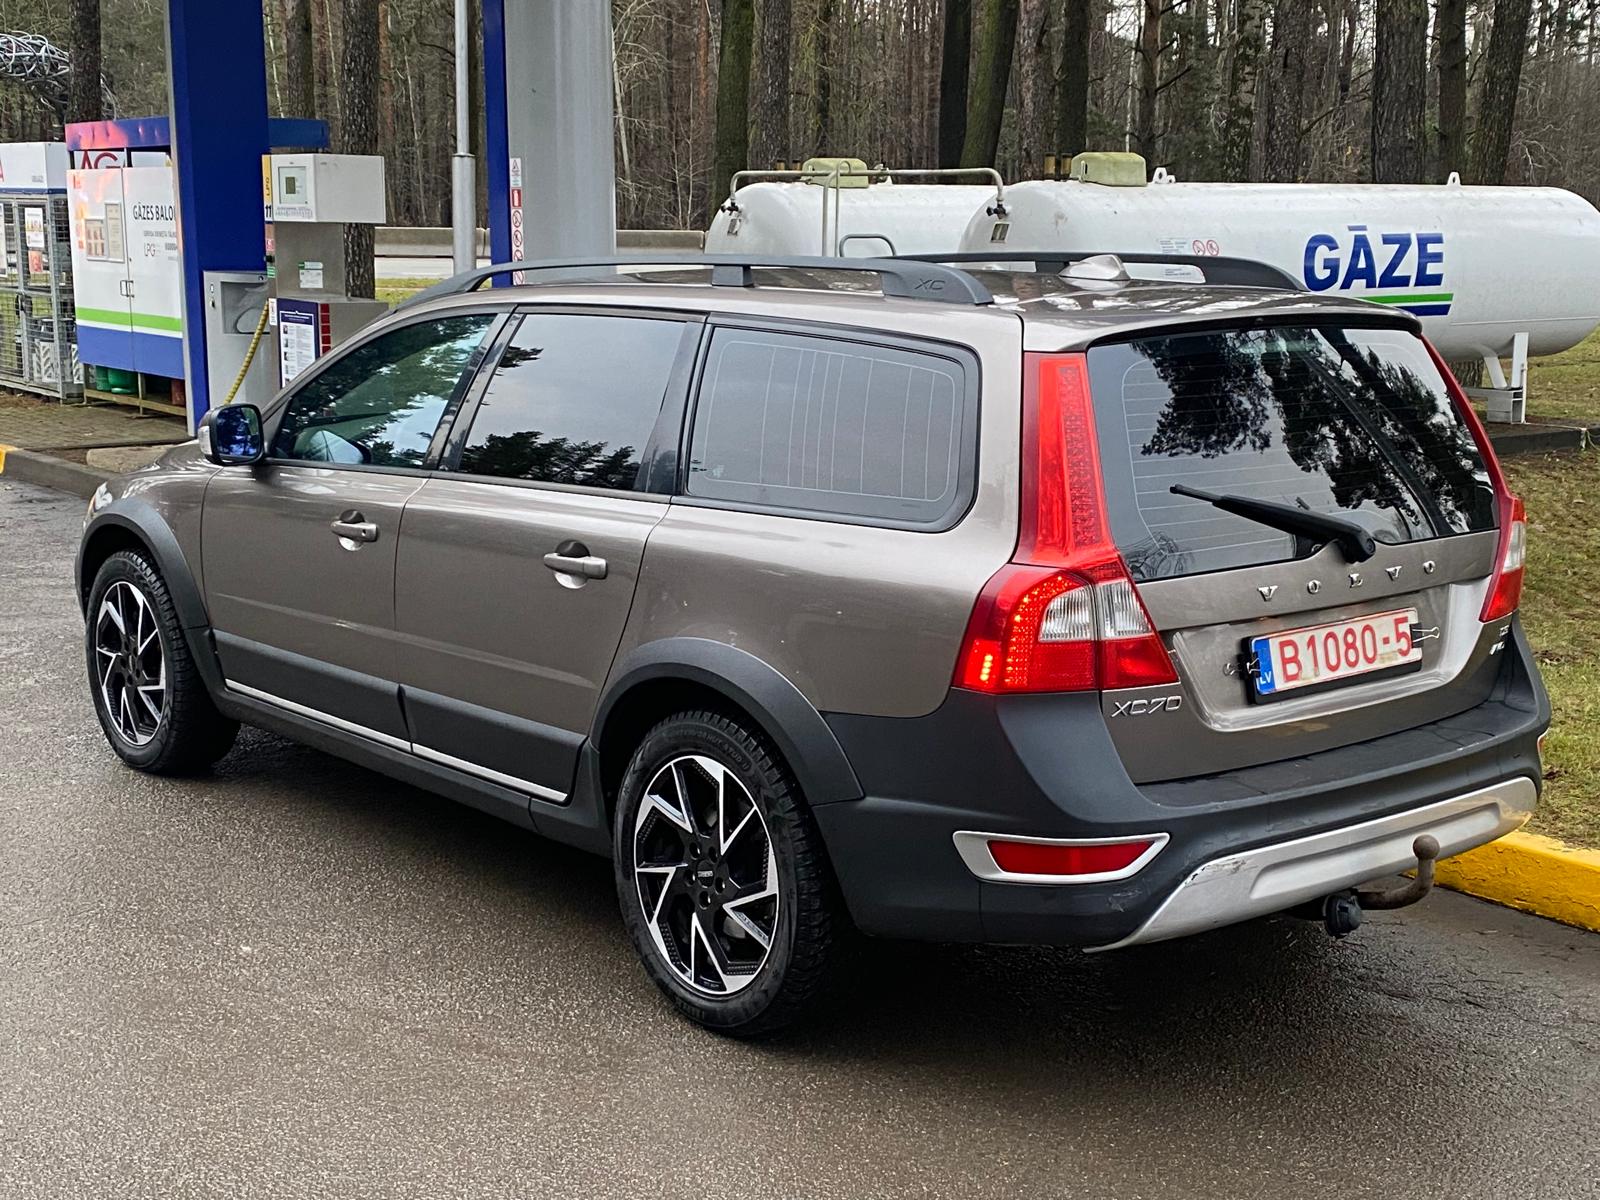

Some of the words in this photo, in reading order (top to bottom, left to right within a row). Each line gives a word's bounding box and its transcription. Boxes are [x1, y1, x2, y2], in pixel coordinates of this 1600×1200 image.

[81, 151, 126, 169] AG
[265, 205, 272, 218] 11
[1303, 225, 1444, 292] GĀZE
[914, 278, 946, 291] XC
[1257, 560, 1437, 601] VOLVO
[1278, 615, 1413, 683] B1080-5
[1259, 671, 1272, 685] LV
[1111, 695, 1182, 717] XC70
